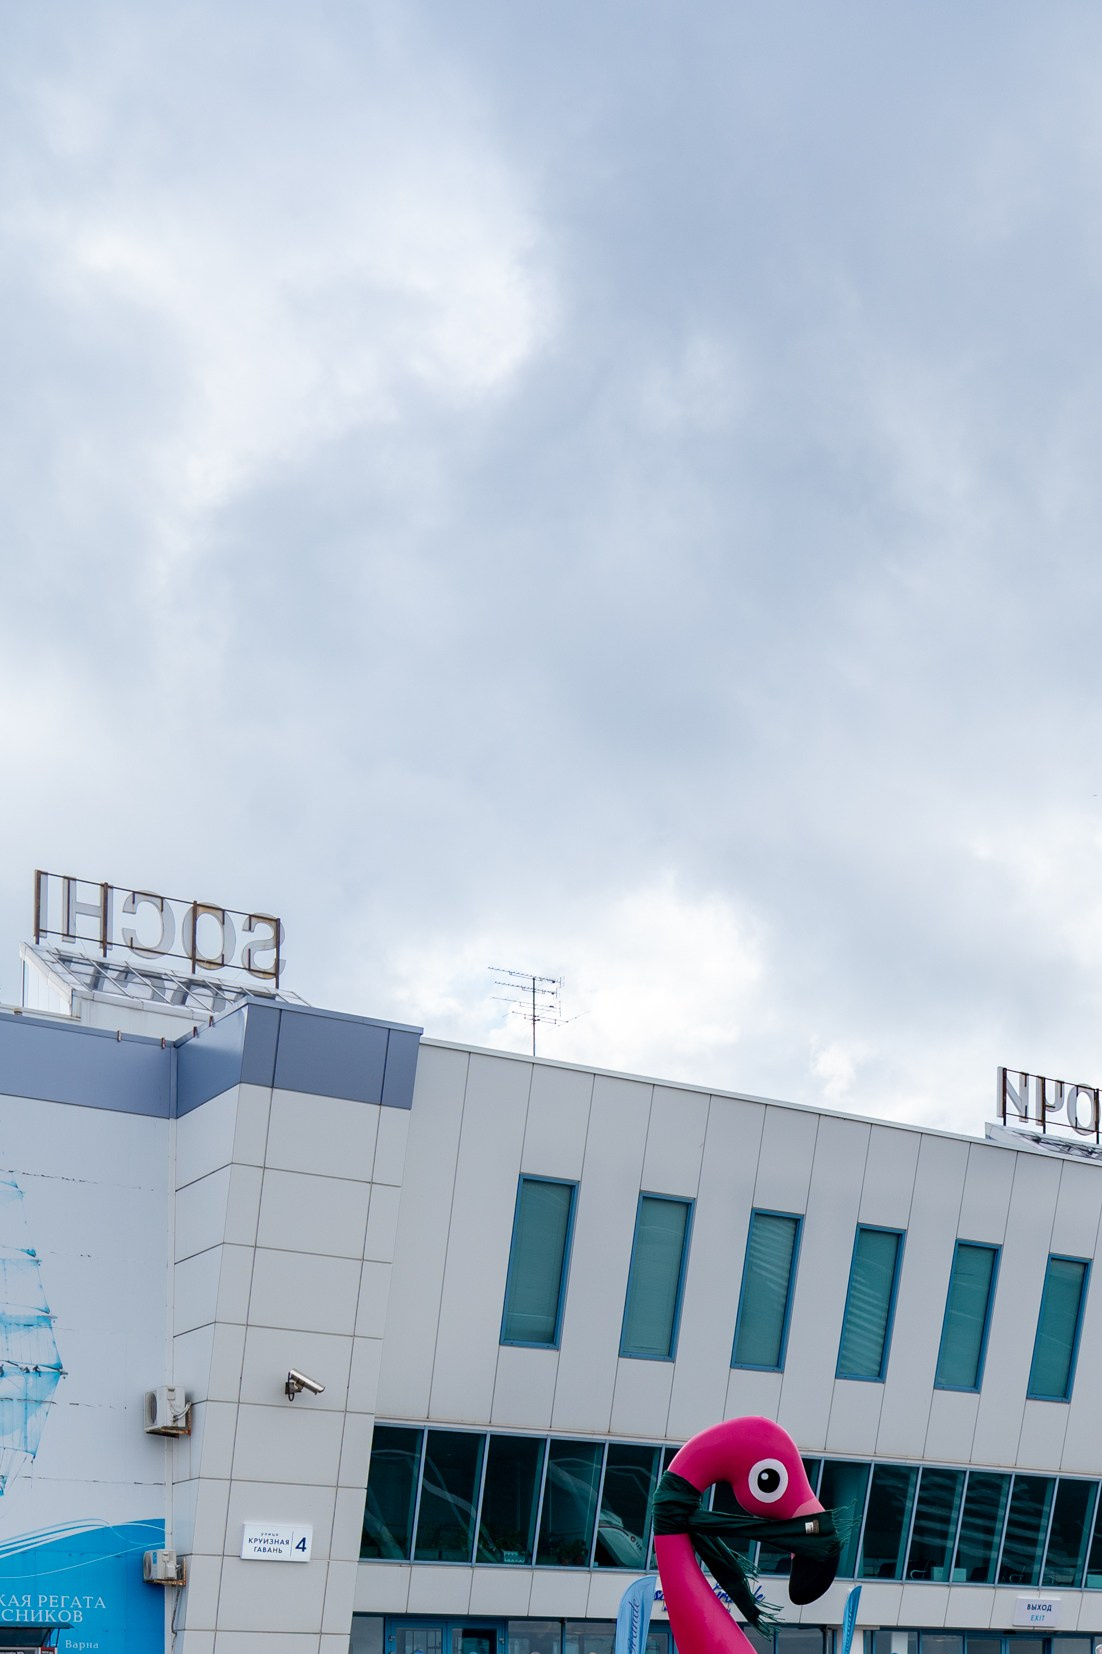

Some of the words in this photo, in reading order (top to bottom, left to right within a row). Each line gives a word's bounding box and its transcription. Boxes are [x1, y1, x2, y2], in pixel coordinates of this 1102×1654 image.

[248, 1537, 290, 1545] КРУИЗНАЯ
[295, 1537, 307, 1553] 4
[253, 1546, 283, 1554] ГАВАНЬ
[38, 1594, 106, 1609] РЕГАТА
[1027, 1603, 1052, 1612] ВЫХОД
[1, 1608, 83, 1623] СНИКОВ
[1030, 1614, 1046, 1622] EXIT
[65, 1639, 99, 1651] Варна
